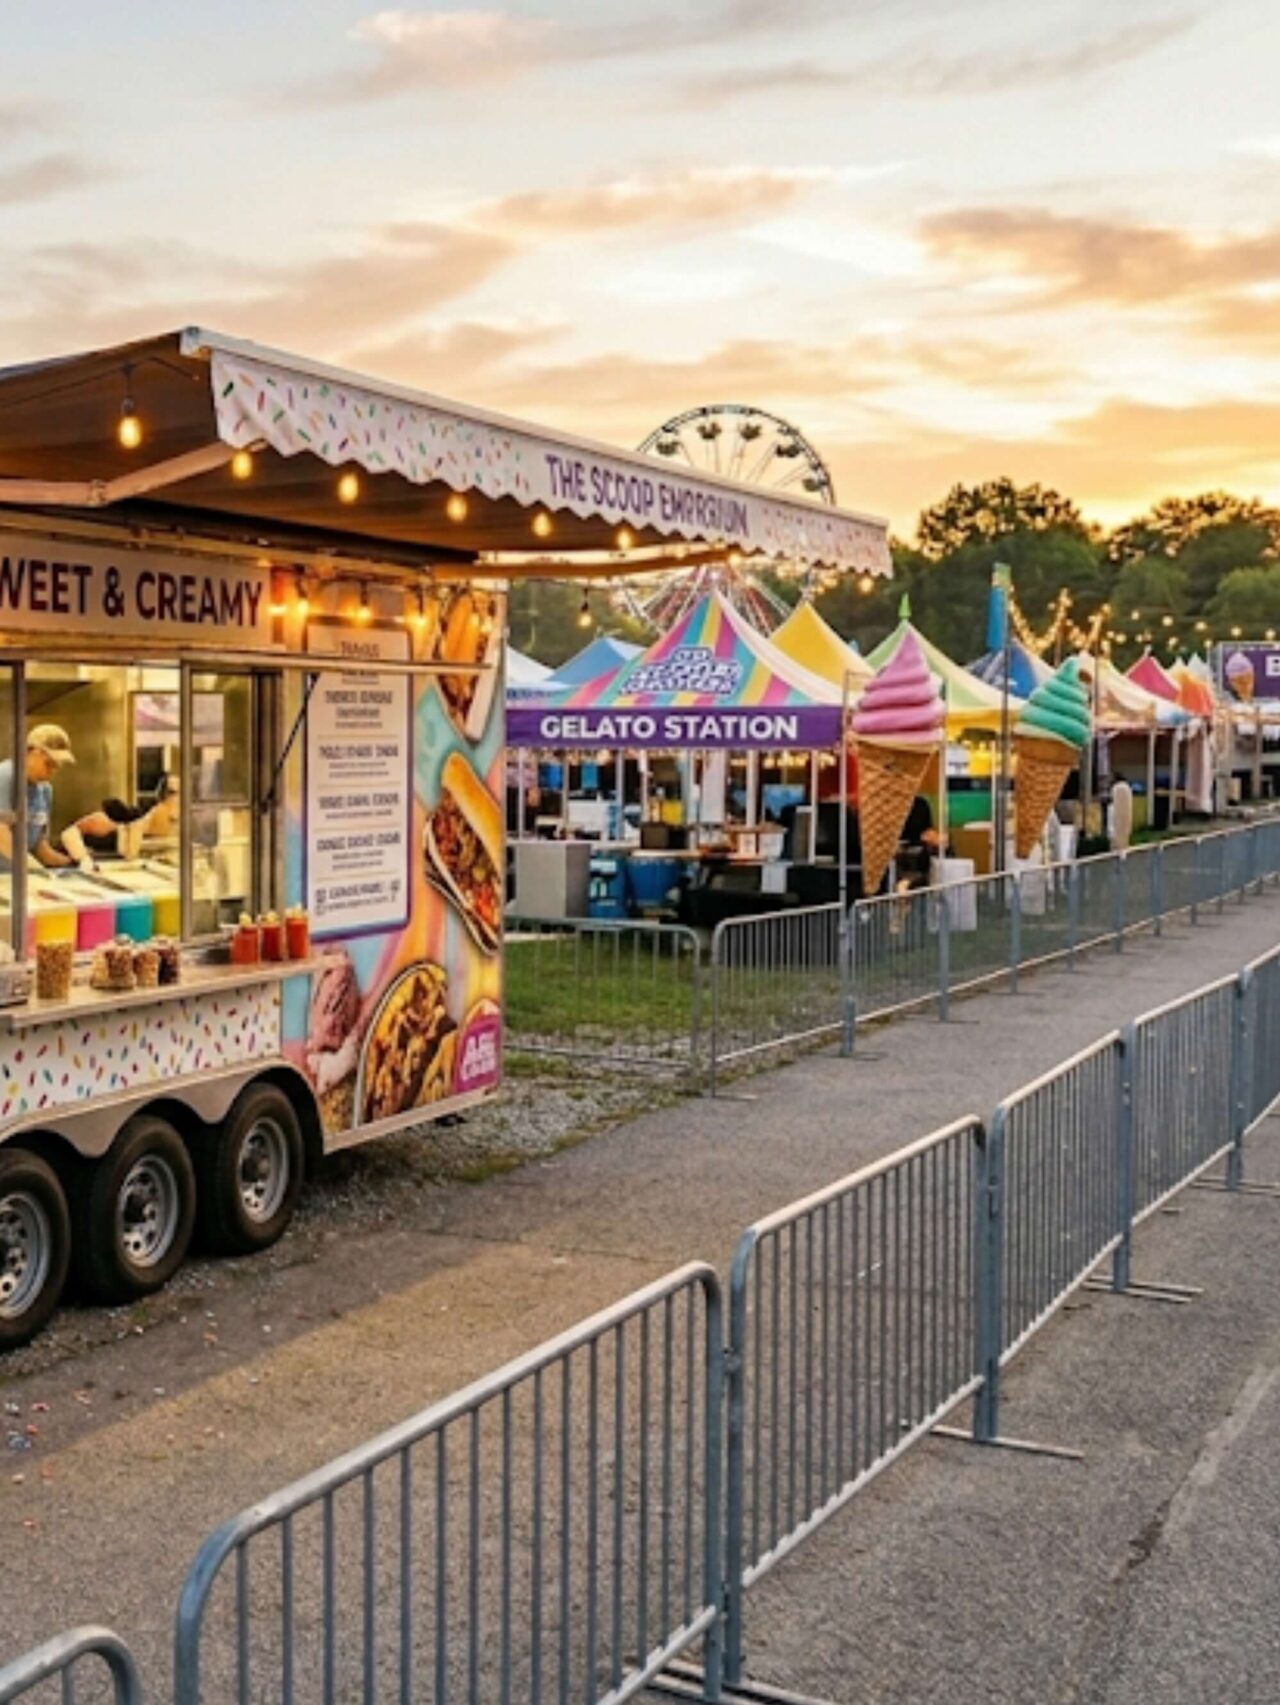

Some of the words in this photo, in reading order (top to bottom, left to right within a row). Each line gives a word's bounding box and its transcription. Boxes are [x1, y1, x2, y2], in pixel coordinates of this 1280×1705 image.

[545, 454, 586, 502] THE
[590, 466, 654, 516] SCOOP
[102, 566, 125, 618] &
[136, 571, 263, 628] CREAMY
[540, 715, 656, 739] GELATO
[664, 715, 798, 739] STATION
